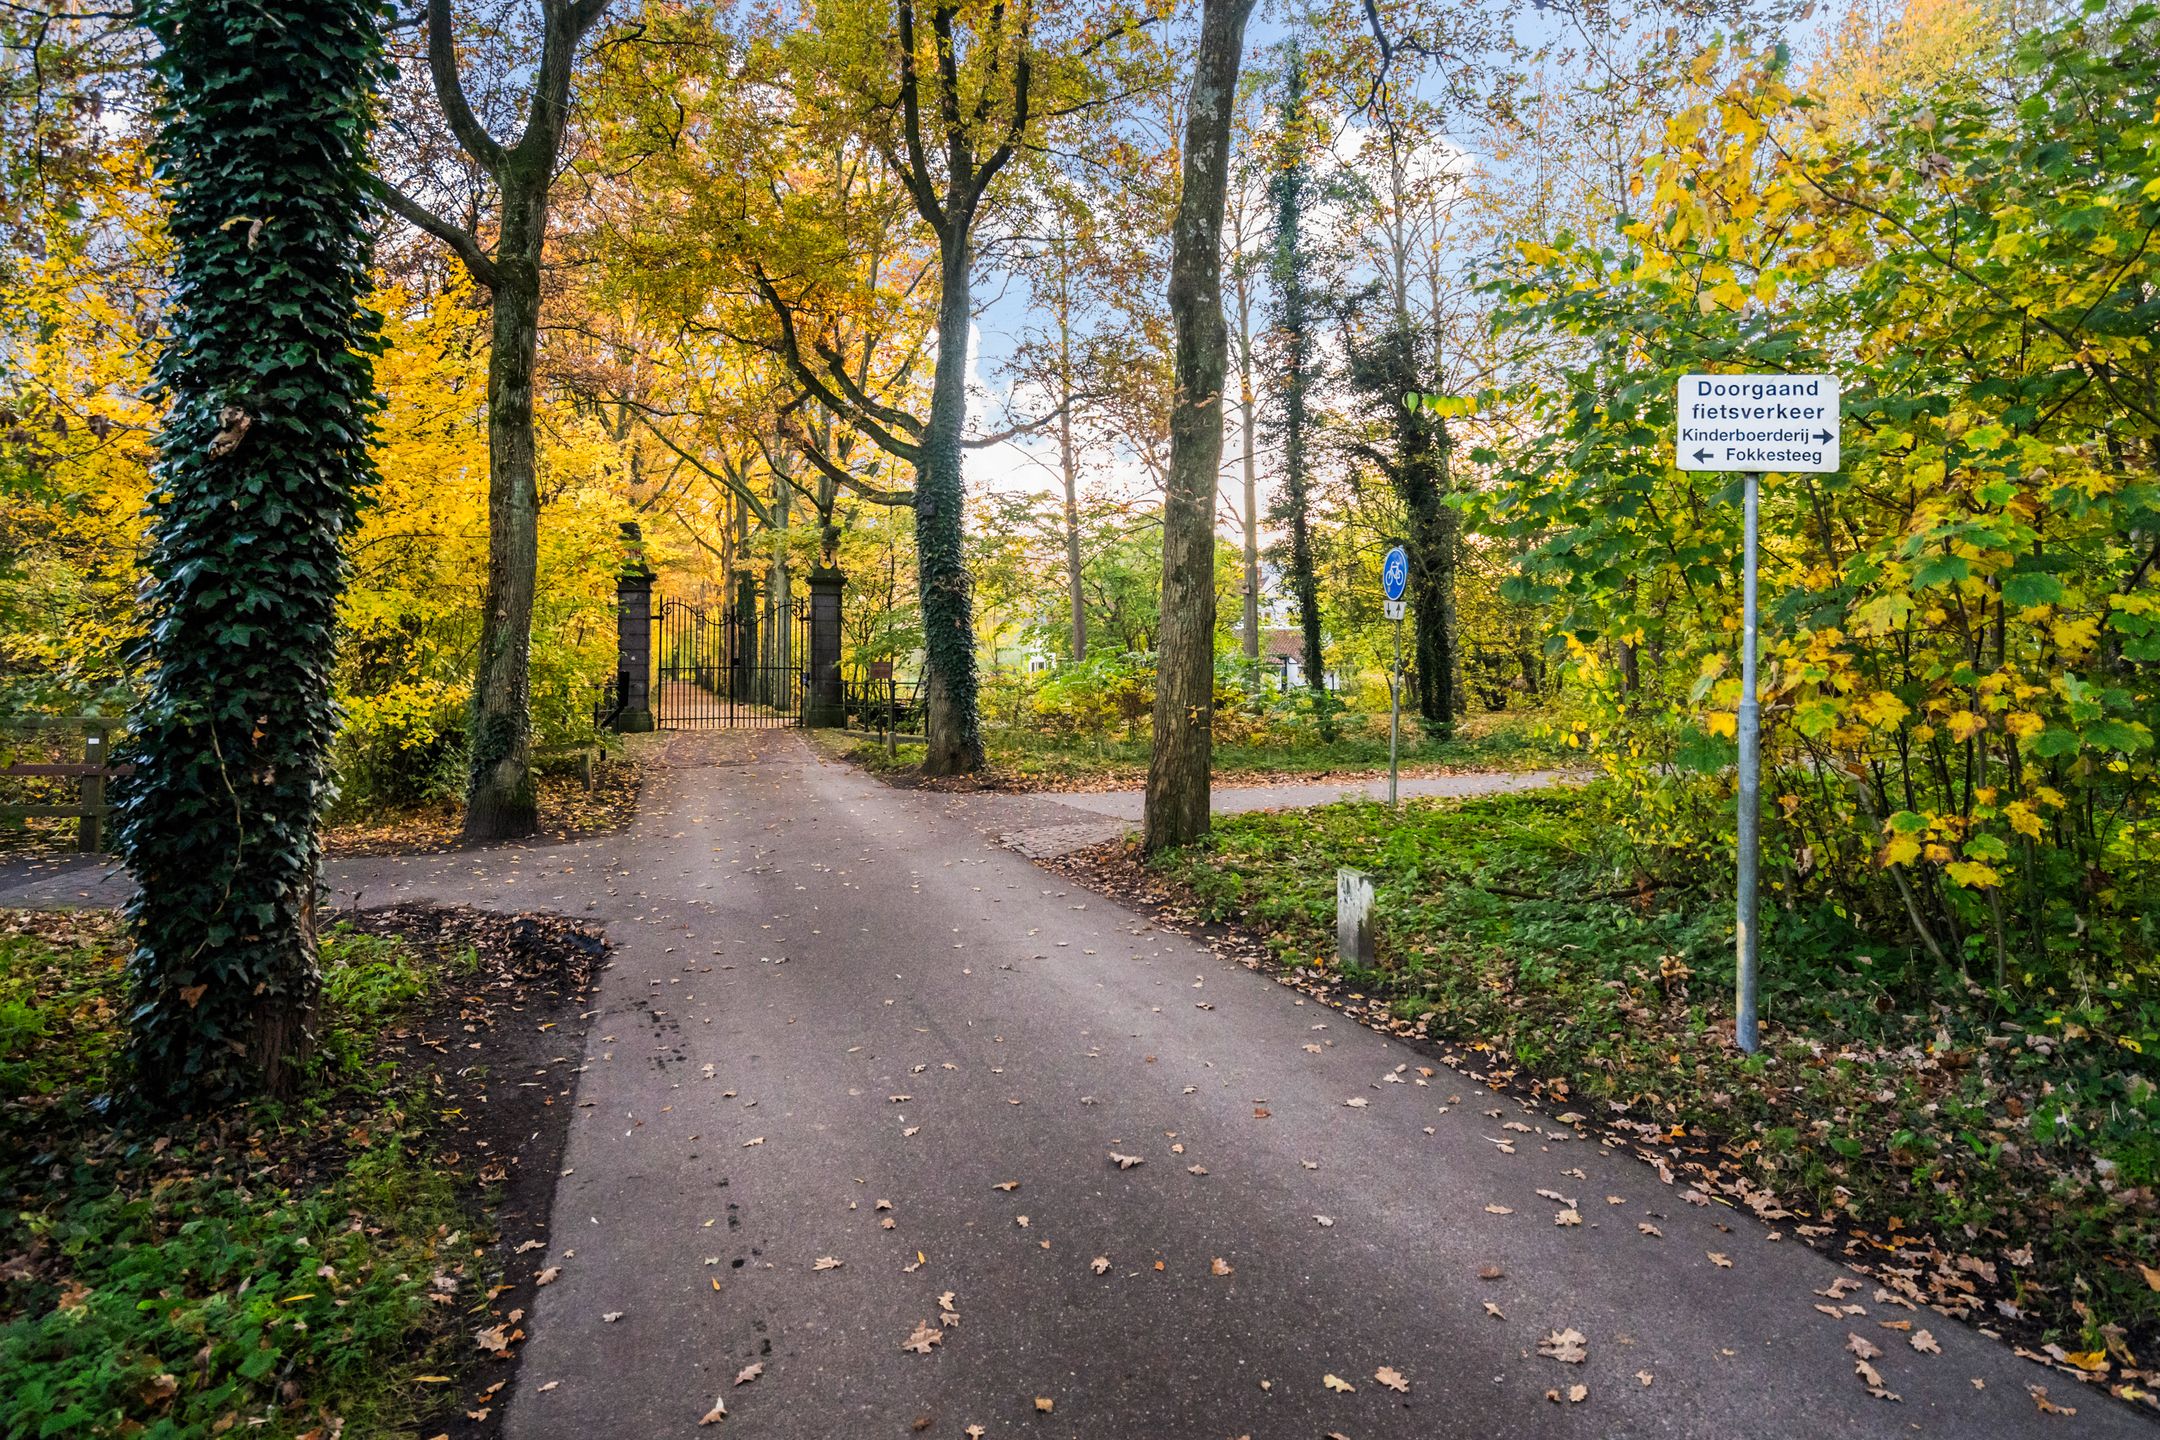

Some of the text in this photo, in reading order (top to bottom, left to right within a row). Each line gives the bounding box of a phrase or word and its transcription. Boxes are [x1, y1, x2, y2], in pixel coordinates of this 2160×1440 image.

[1698, 381, 1818, 399] Doorgaand
[1692, 404, 1825, 419] fietsverkeer
[1682, 429, 1809, 444] Kinderboerderij
[1727, 448, 1822, 464] Fokkesteeg
